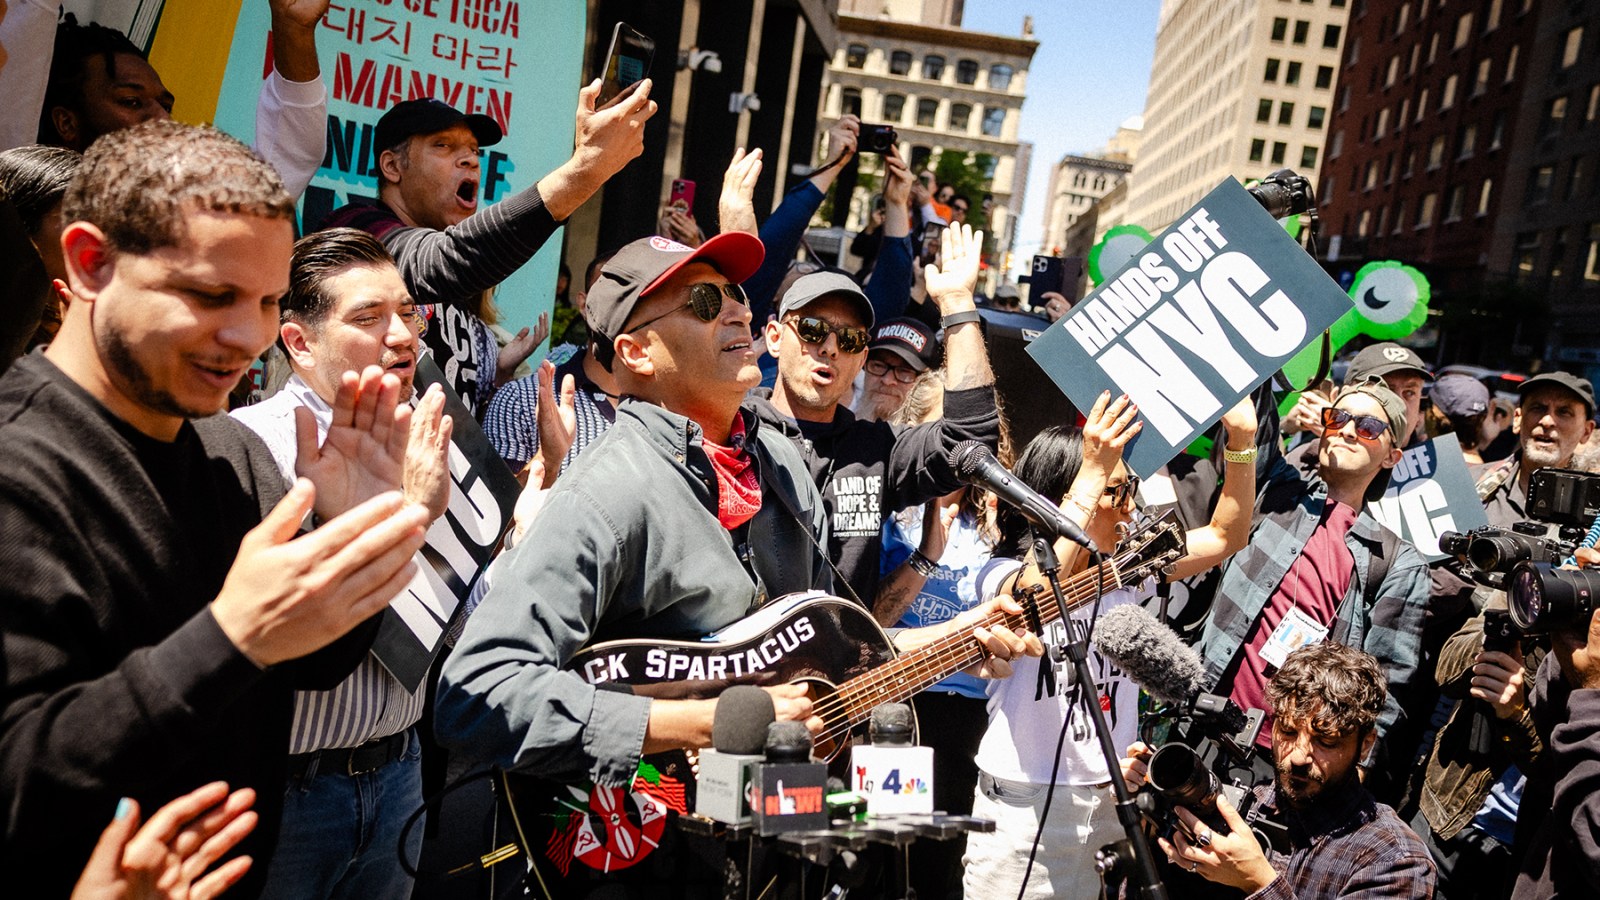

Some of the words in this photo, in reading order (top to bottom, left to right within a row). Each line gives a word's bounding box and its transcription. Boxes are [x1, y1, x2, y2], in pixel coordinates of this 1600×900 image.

[450, 0, 519, 39] TOCA
[432, 33, 518, 79] 마라
[1062, 252, 1180, 357] HANDS
[1162, 207, 1228, 273] OFF
[877, 324, 925, 351] VARUKERS
[1095, 251, 1308, 447] NYC
[1391, 444, 1431, 482] OFF
[832, 476, 865, 495] LAND
[865, 475, 881, 494] OF
[837, 494, 867, 512] HOPE
[869, 494, 880, 512] &
[833, 512, 881, 531] DREAMS
[1367, 477, 1458, 556] YC
[928, 568, 965, 581] GRA
[583, 652, 629, 685] CK
[645, 616, 816, 681] SPARTACUS
[882, 768, 902, 795] 4
